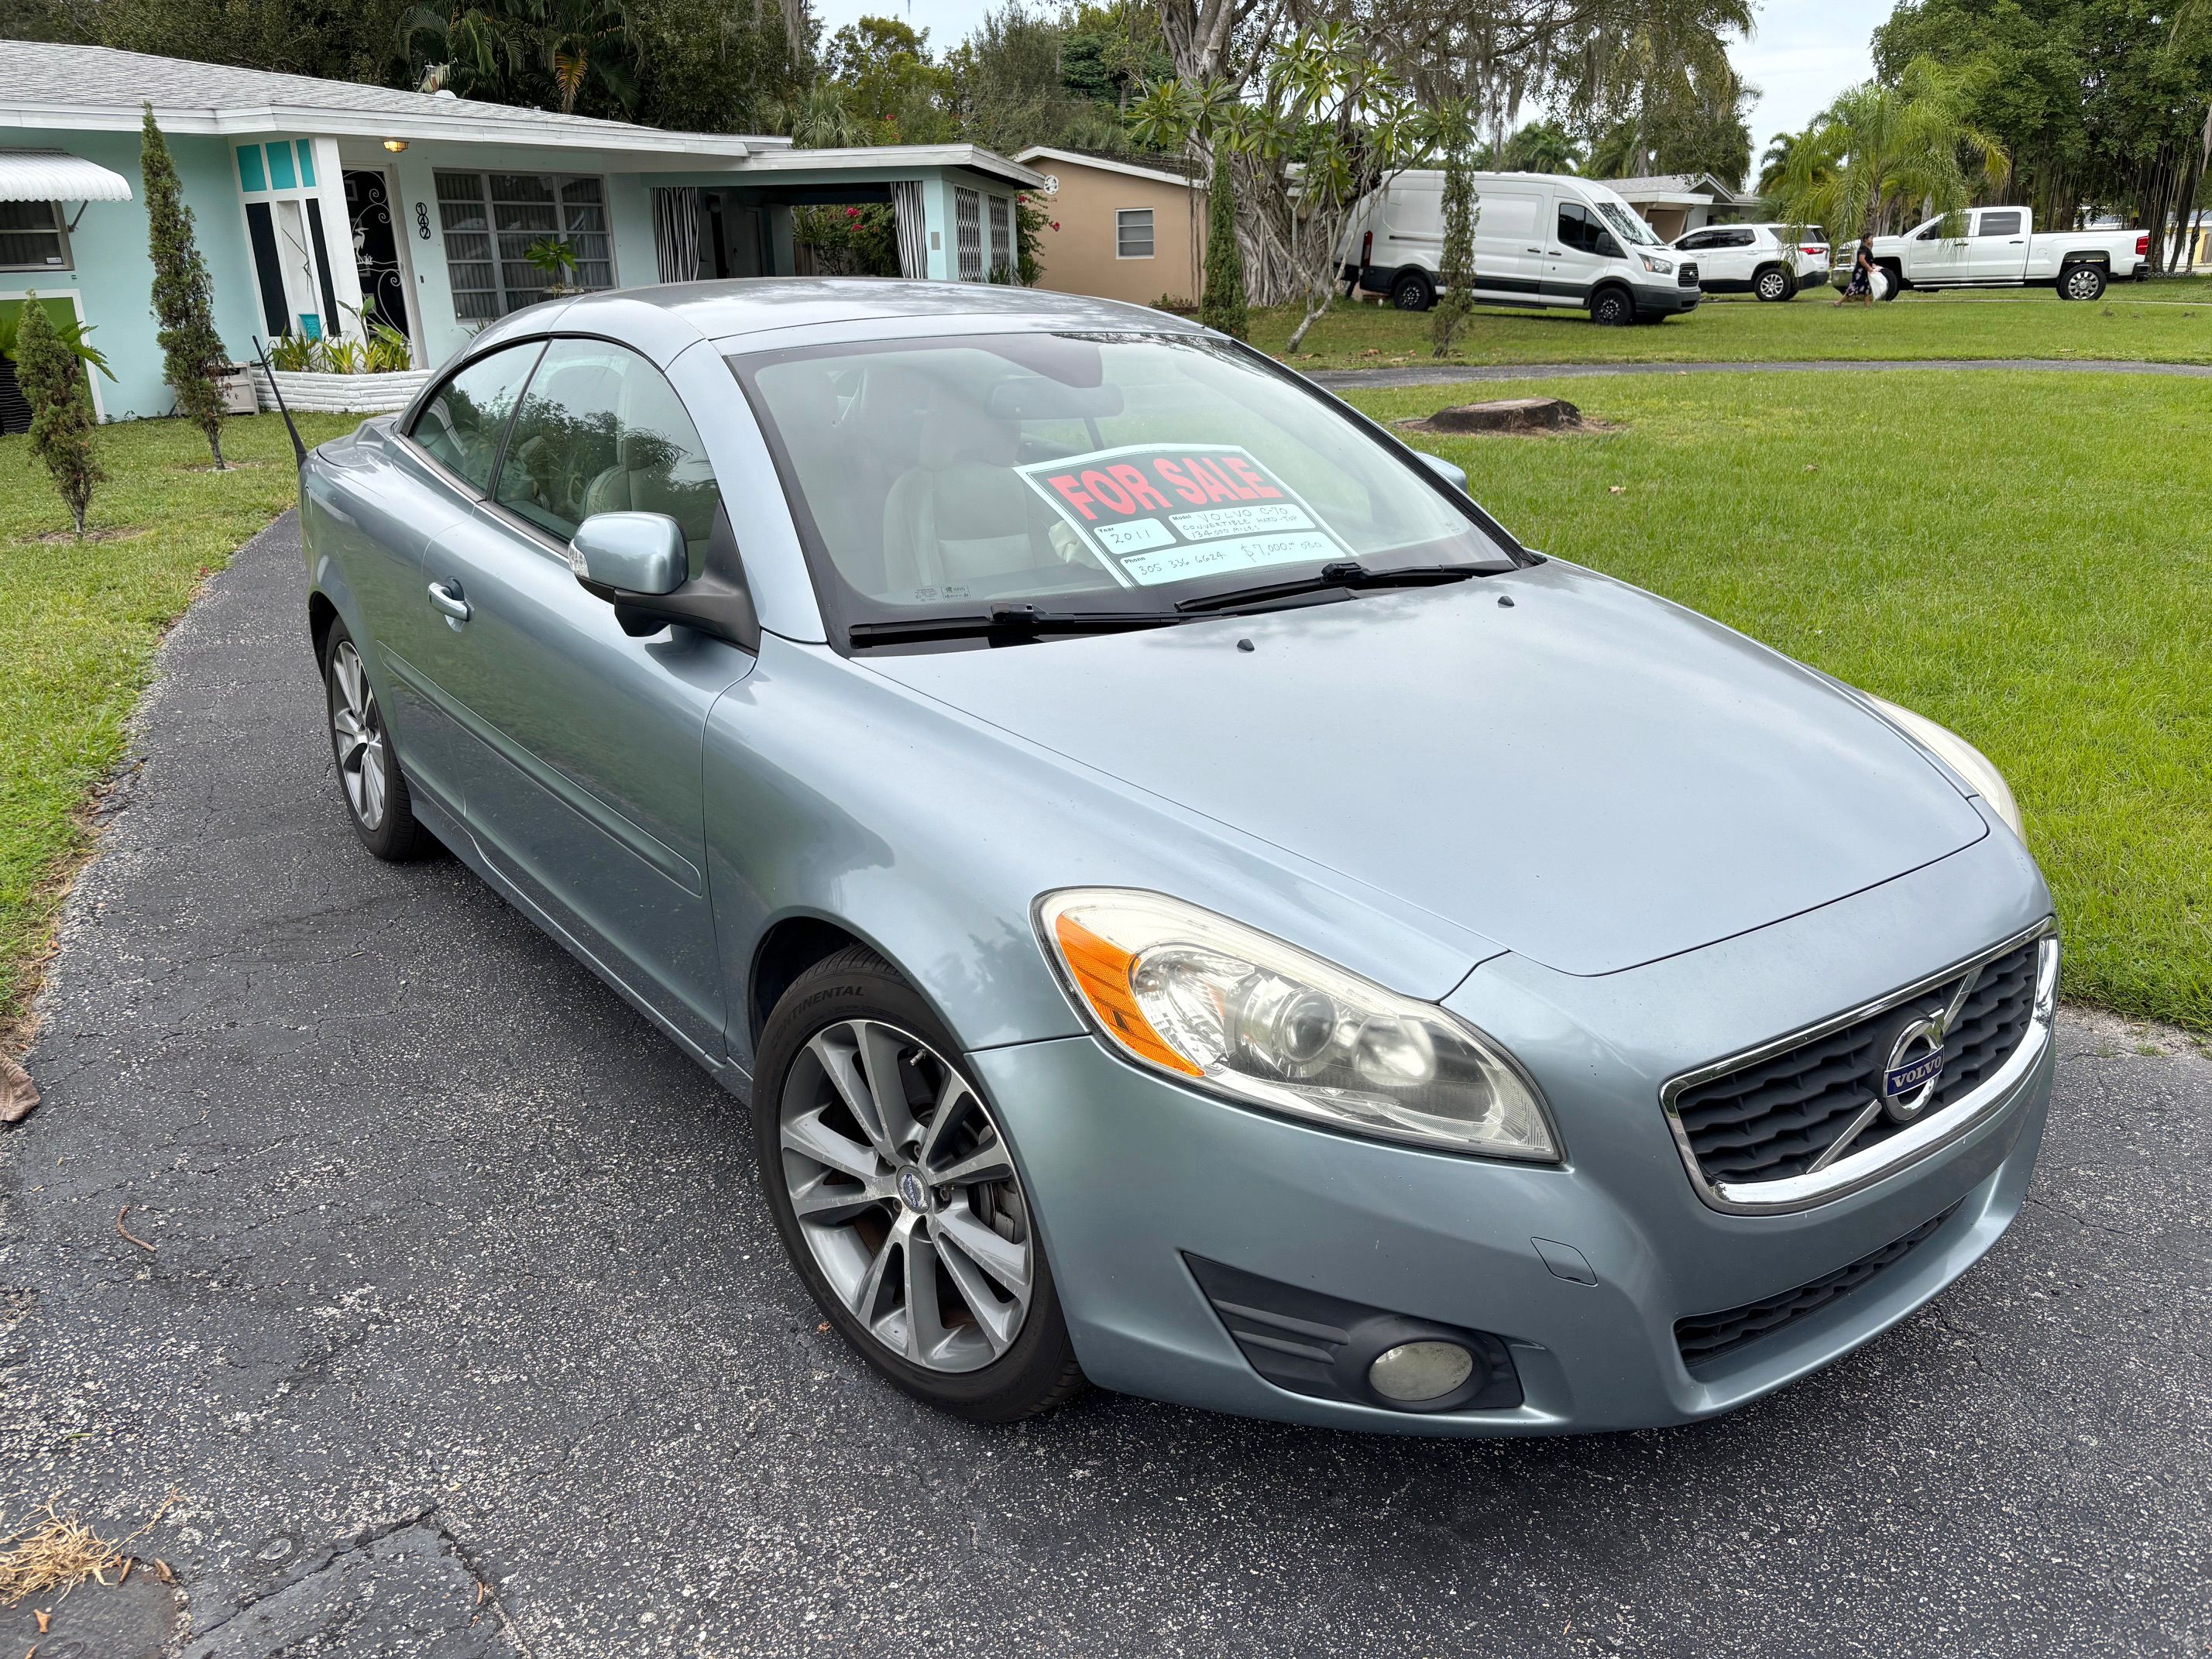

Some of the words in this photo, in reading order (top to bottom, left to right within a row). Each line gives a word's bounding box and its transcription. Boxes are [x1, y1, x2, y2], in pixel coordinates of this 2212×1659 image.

[417, 202, 431, 239] 142
[1047, 464, 1173, 520] FOR
[1153, 458, 1283, 504] SALE
[1183, 519, 1251, 530] CONVERTIBLE
[1197, 510, 1252, 523] VOLVO
[1110, 529, 1151, 544] 2011
[1139, 563, 1163, 575] 305
[1168, 558, 1190, 568] 336
[1195, 551, 1226, 563] 6624
[1300, 541, 1321, 550] OBO
[772, 985, 865, 1049] CONTINENTAL
[1892, 1056, 1941, 1087] VOLVO
